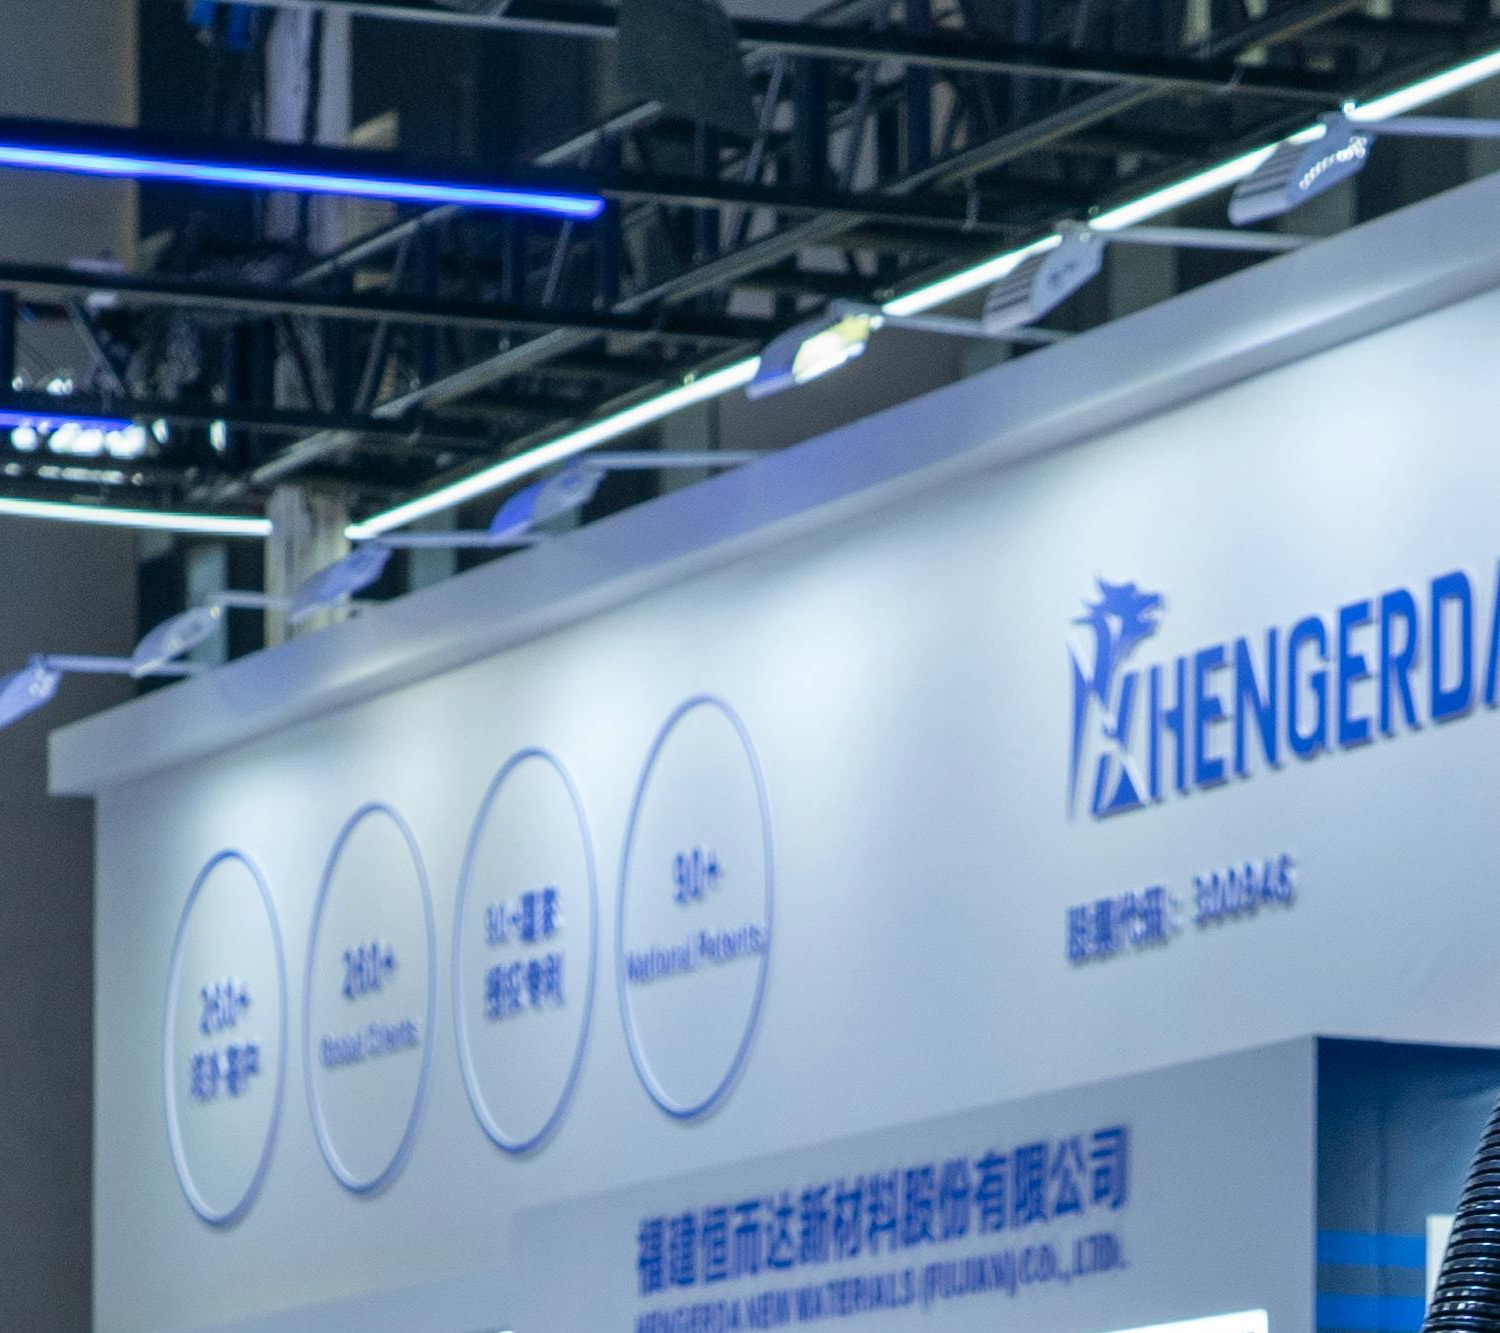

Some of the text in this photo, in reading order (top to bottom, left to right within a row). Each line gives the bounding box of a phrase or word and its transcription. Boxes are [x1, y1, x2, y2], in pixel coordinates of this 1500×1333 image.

[637, 1124, 1130, 1297] 福建恒而达新材料股份有限公司
[796, 1268, 916, 1324] MATERIALS
